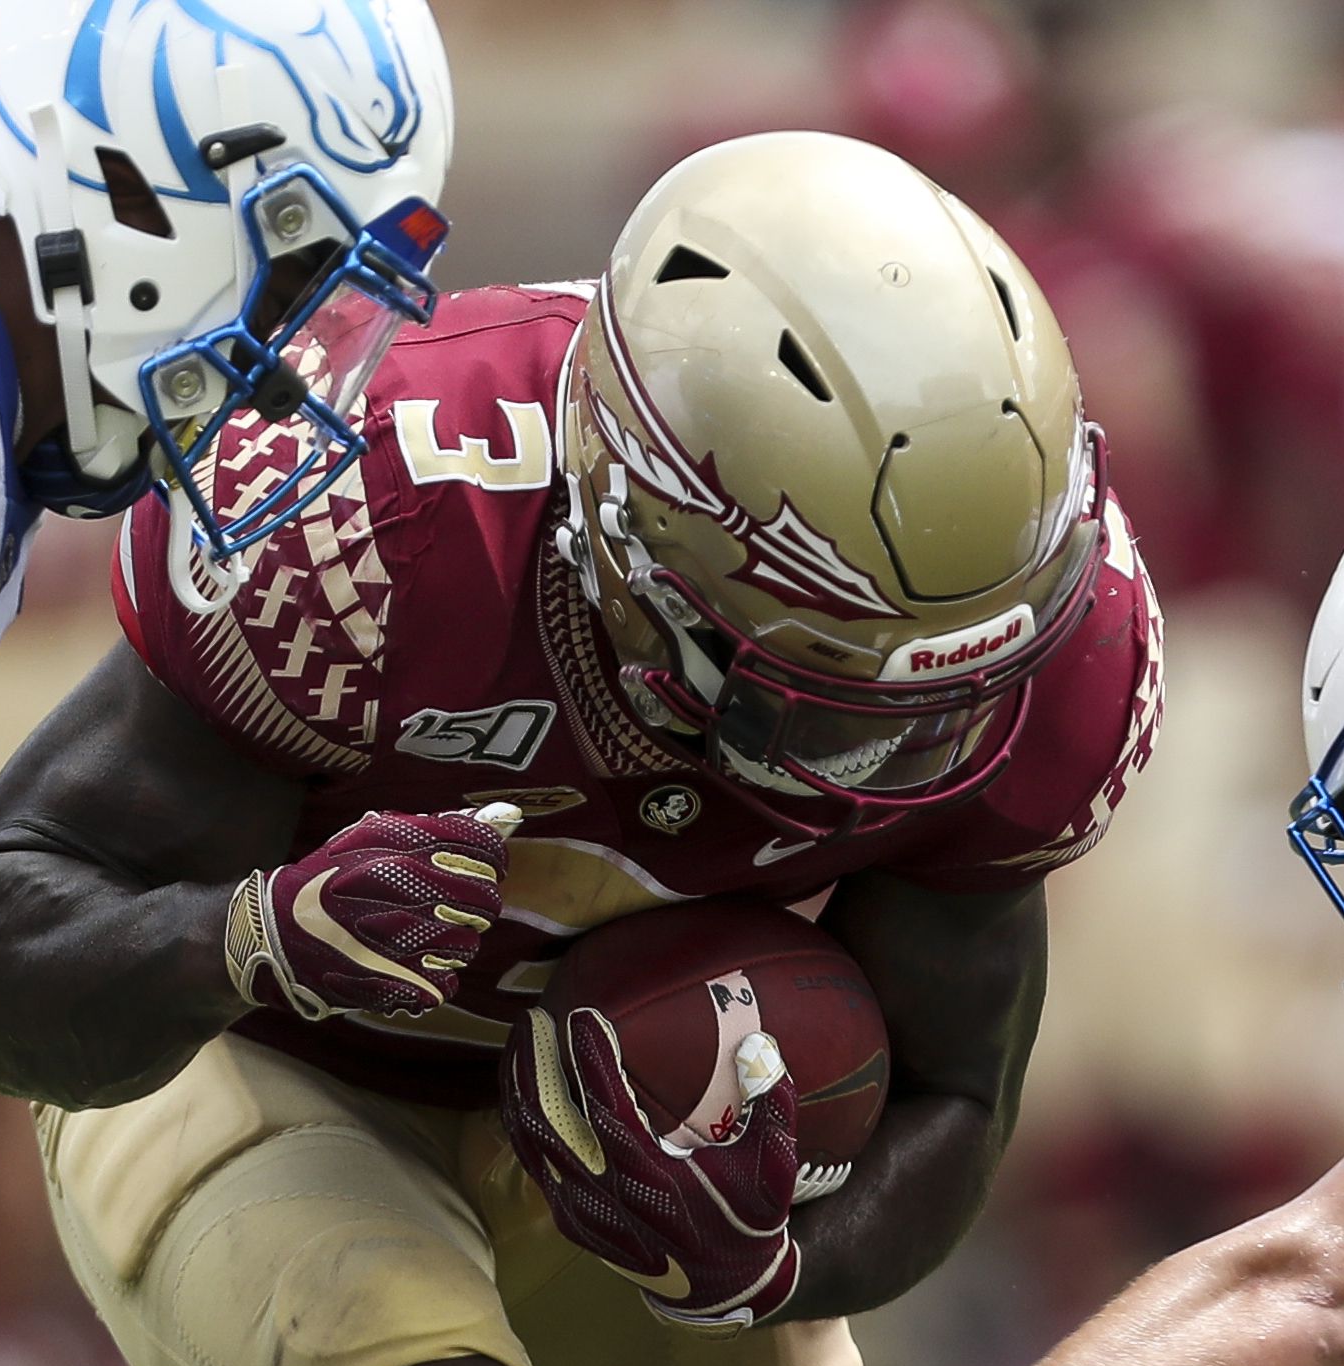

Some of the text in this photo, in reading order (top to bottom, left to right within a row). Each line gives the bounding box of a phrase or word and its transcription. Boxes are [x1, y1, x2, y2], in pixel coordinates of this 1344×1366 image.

[392, 398, 555, 492] 3
[911, 618, 1022, 672] Riddell
[409, 704, 552, 766] 150
